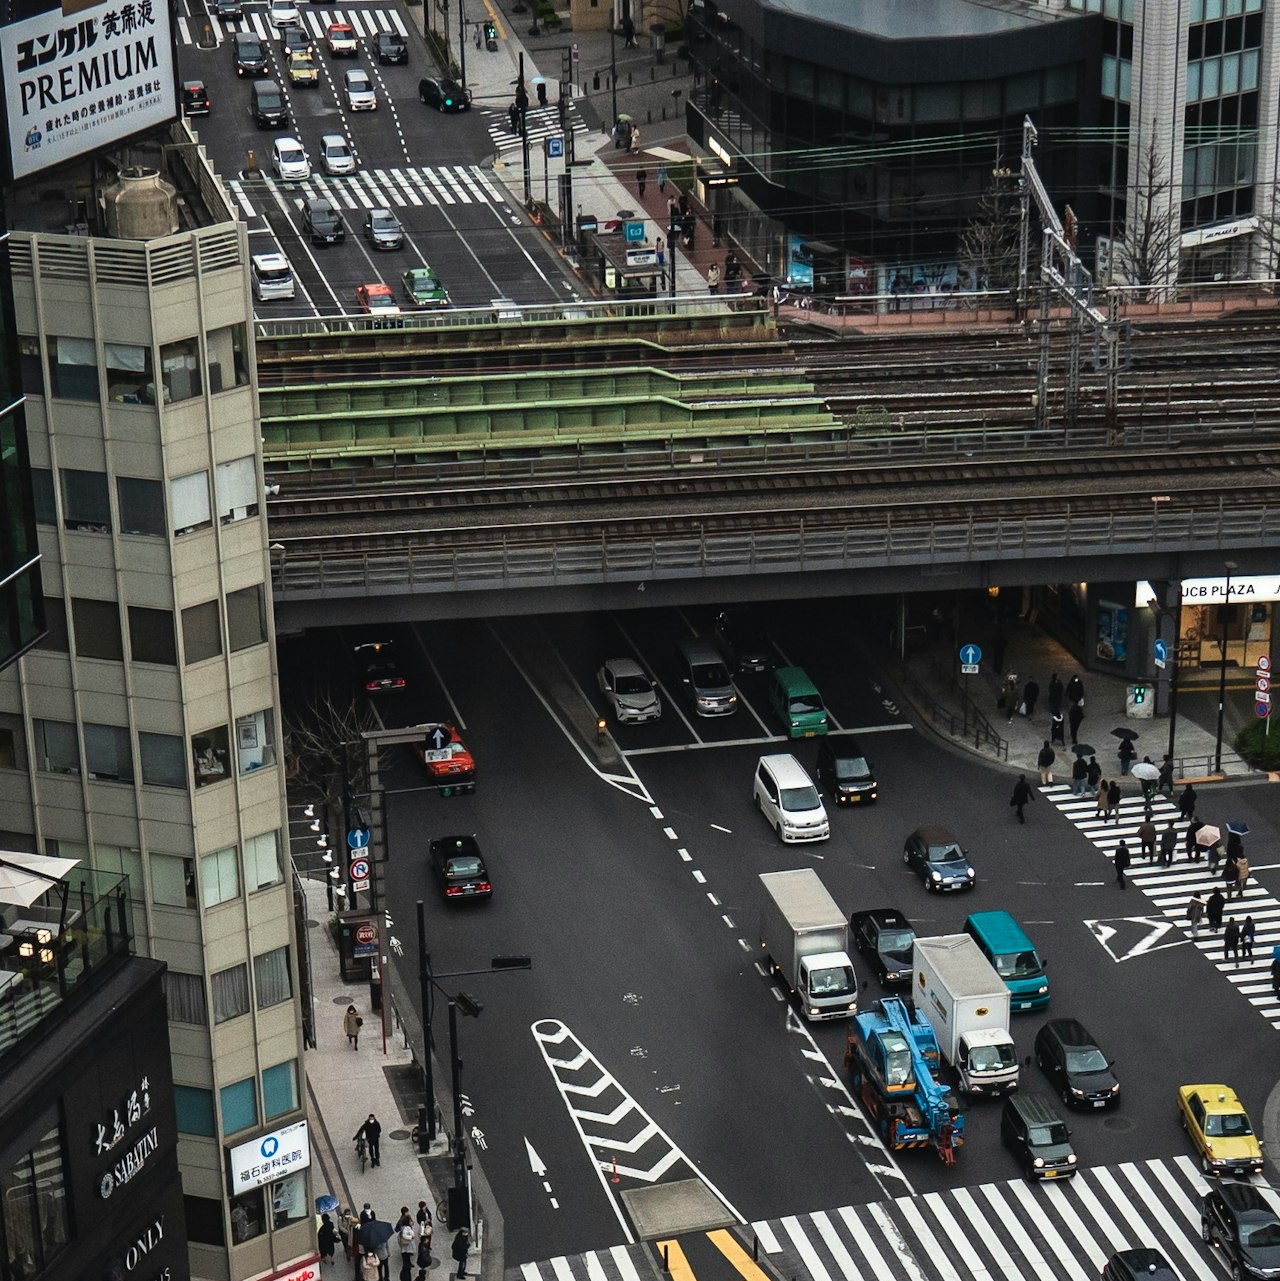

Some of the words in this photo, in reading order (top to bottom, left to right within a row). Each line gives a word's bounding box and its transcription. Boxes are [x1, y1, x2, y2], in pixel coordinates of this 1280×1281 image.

[19, 35, 159, 117] PREMIUM
[1211, 583, 1256, 596] PLAZA
[114, 1125, 160, 1187] SABATINI
[125, 1215, 165, 1272] ONLY
